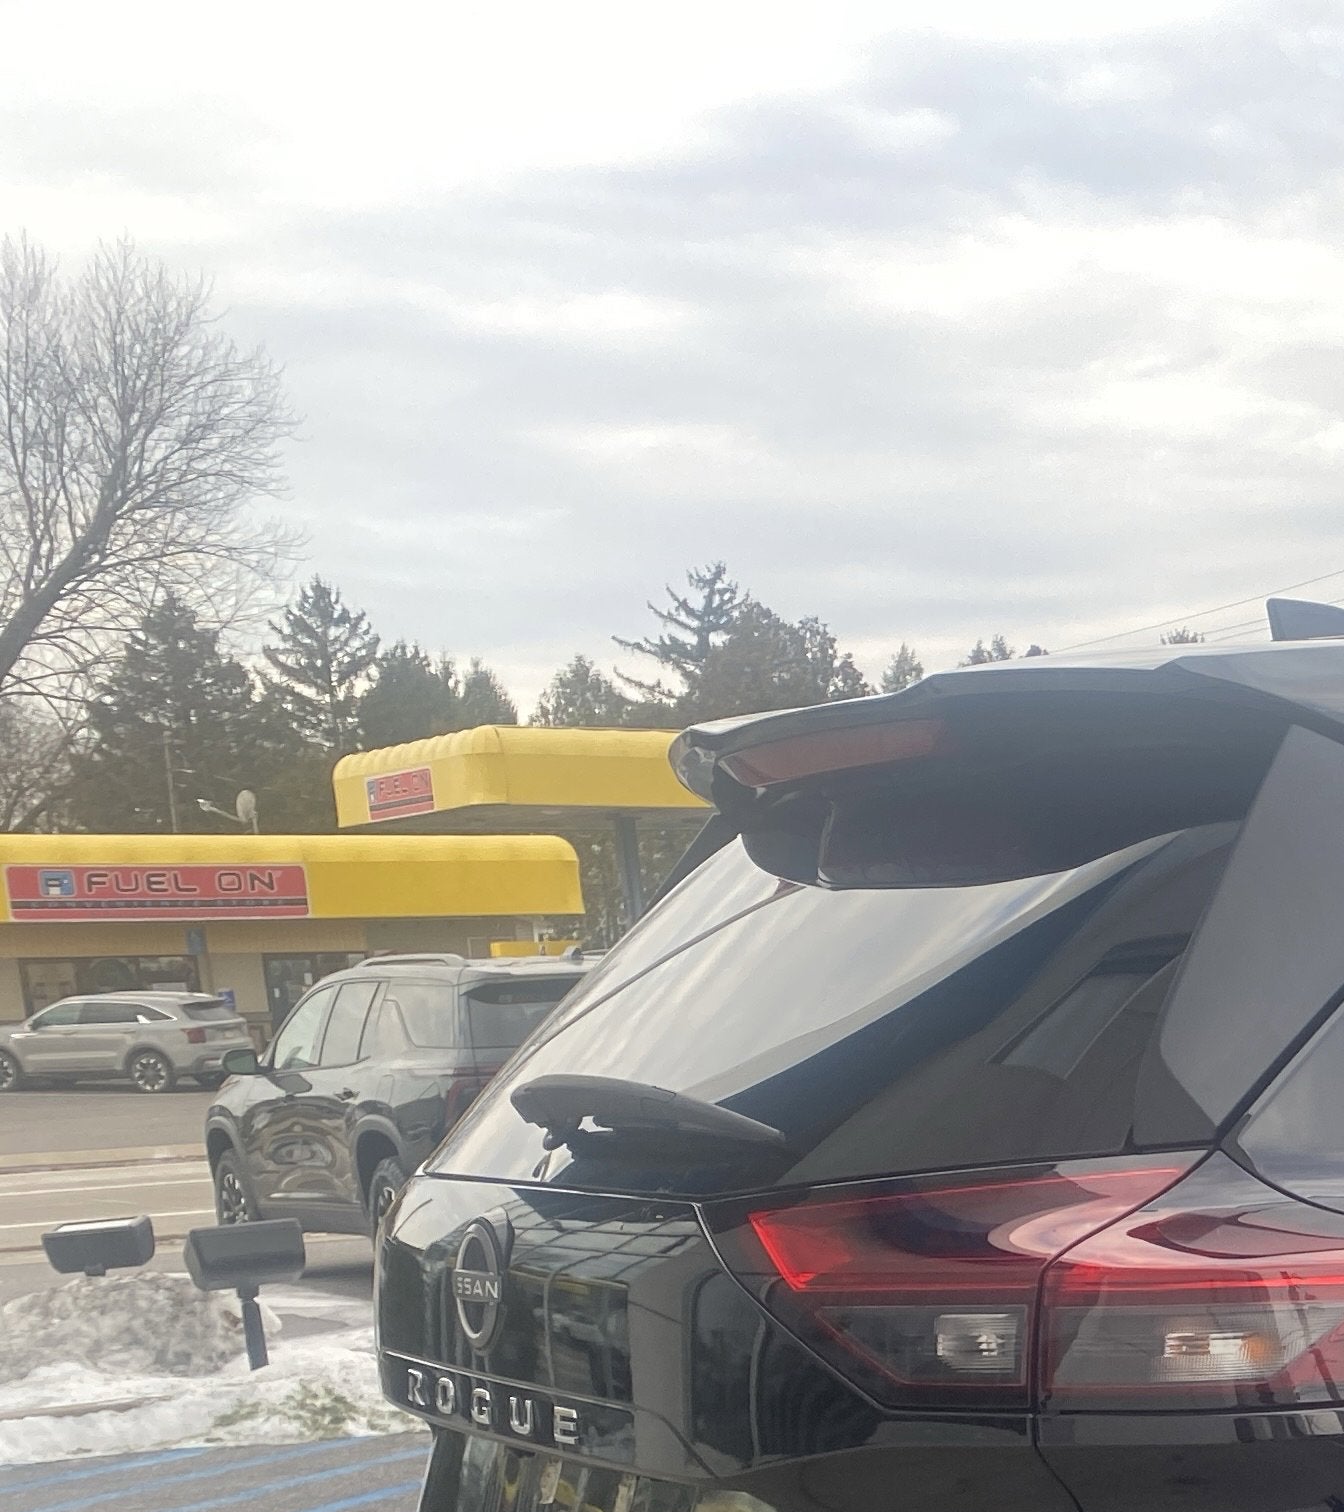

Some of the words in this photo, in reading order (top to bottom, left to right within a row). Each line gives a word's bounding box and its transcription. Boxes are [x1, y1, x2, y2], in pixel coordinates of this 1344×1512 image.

[86, 872, 198, 892] FUEL
[217, 872, 276, 892] ON
[407, 1368, 580, 1446] ROGUE
